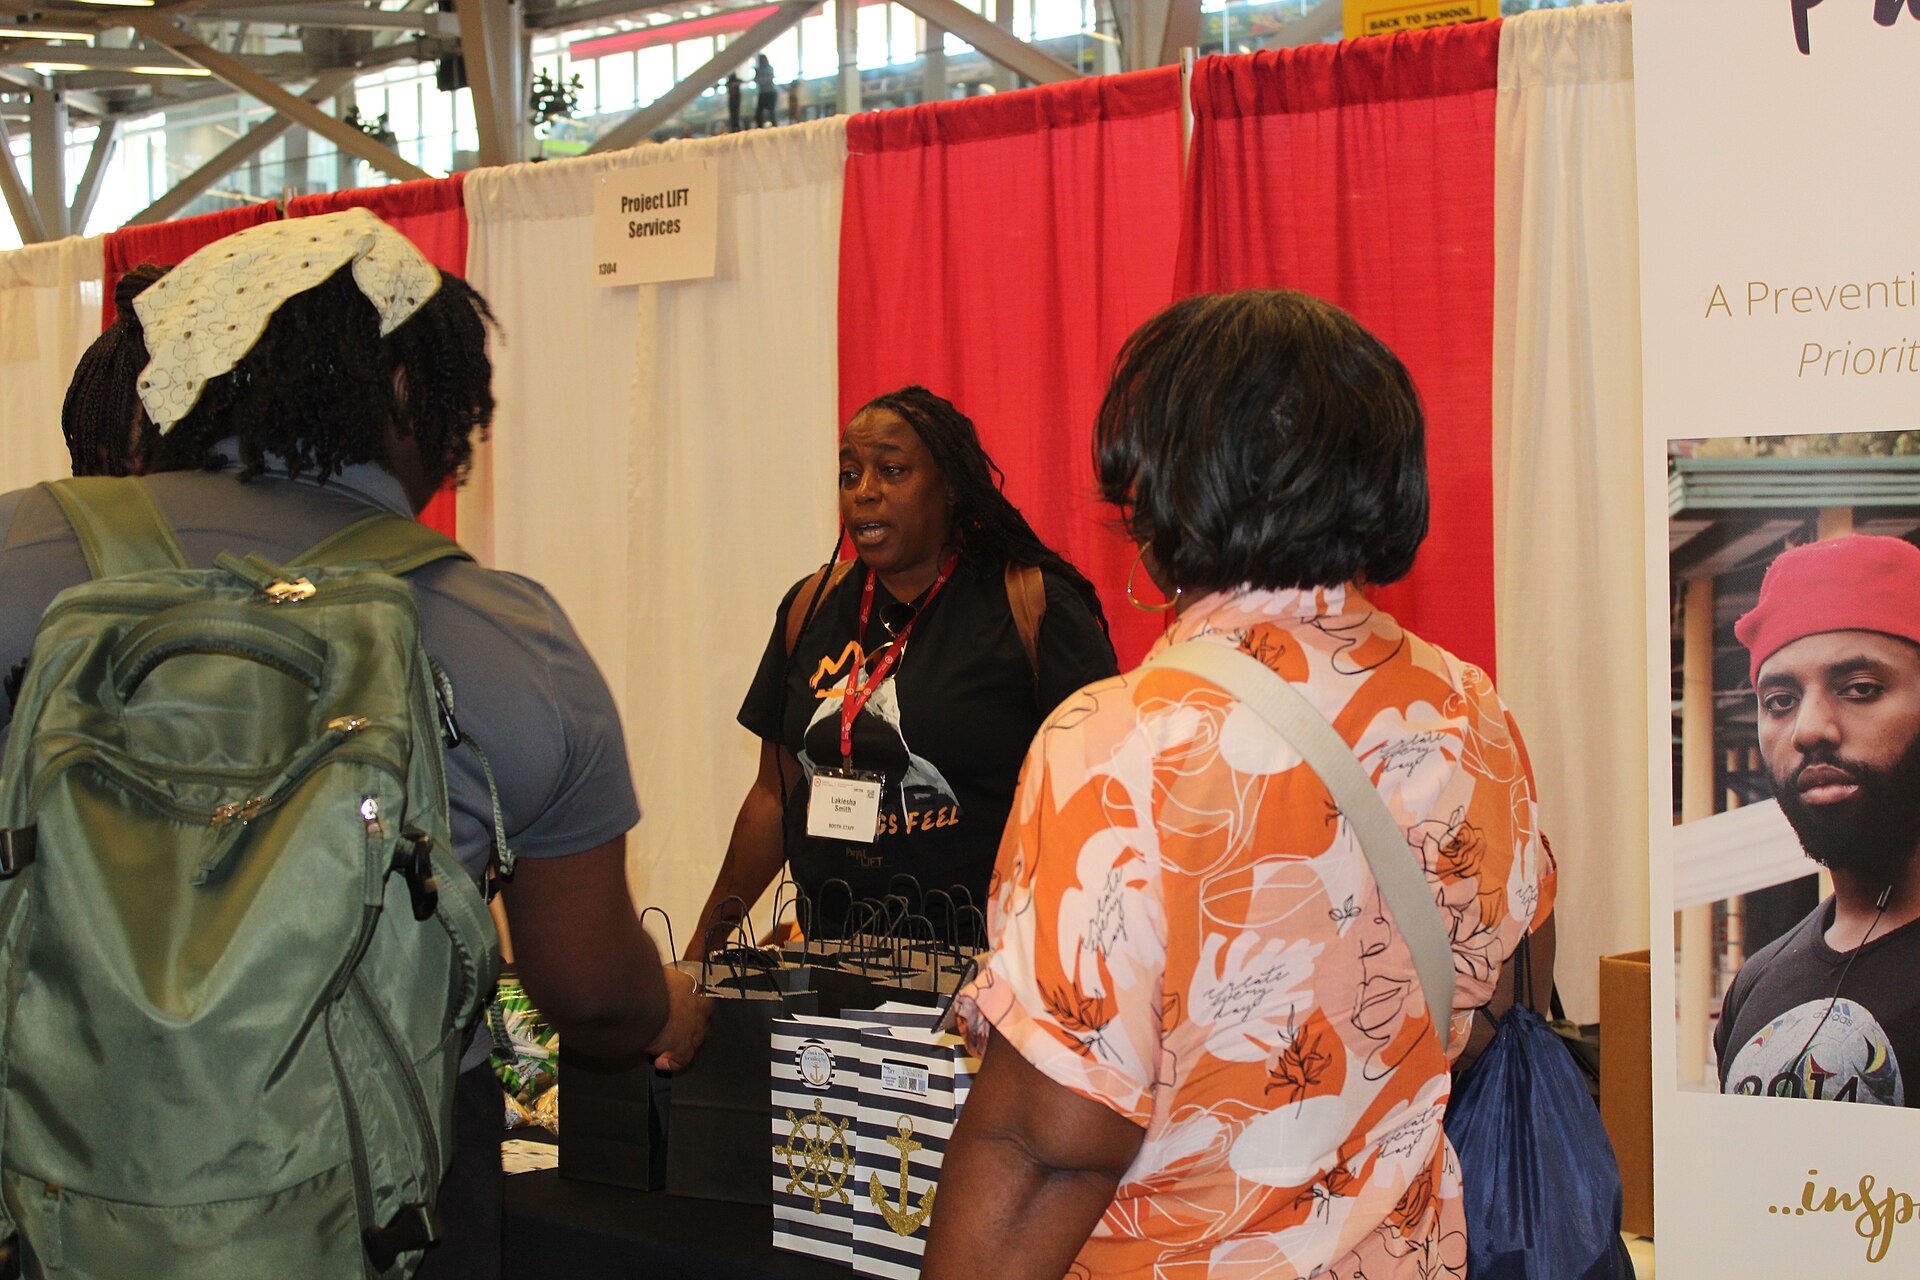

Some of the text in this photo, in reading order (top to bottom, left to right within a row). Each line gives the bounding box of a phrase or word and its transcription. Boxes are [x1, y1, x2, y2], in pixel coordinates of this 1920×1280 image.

[1368, 7, 1472, 30] BACK TO SCHOOL
[621, 188, 689, 213] Project LIFT
[628, 218, 681, 239] Services
[599, 262, 617, 275] 1304
[1704, 271, 1917, 319] A Preventi
[1798, 337, 1920, 378] Priorit
[831, 796, 857, 806] Lakiesha
[834, 805, 852, 813] Smith
[906, 805, 959, 835] FEEL
[1202, 963, 1290, 999] create
[1213, 998, 1257, 1023] day
[1376, 1139, 1413, 1158] day
[1768, 1168, 1920, 1263] ...insp
